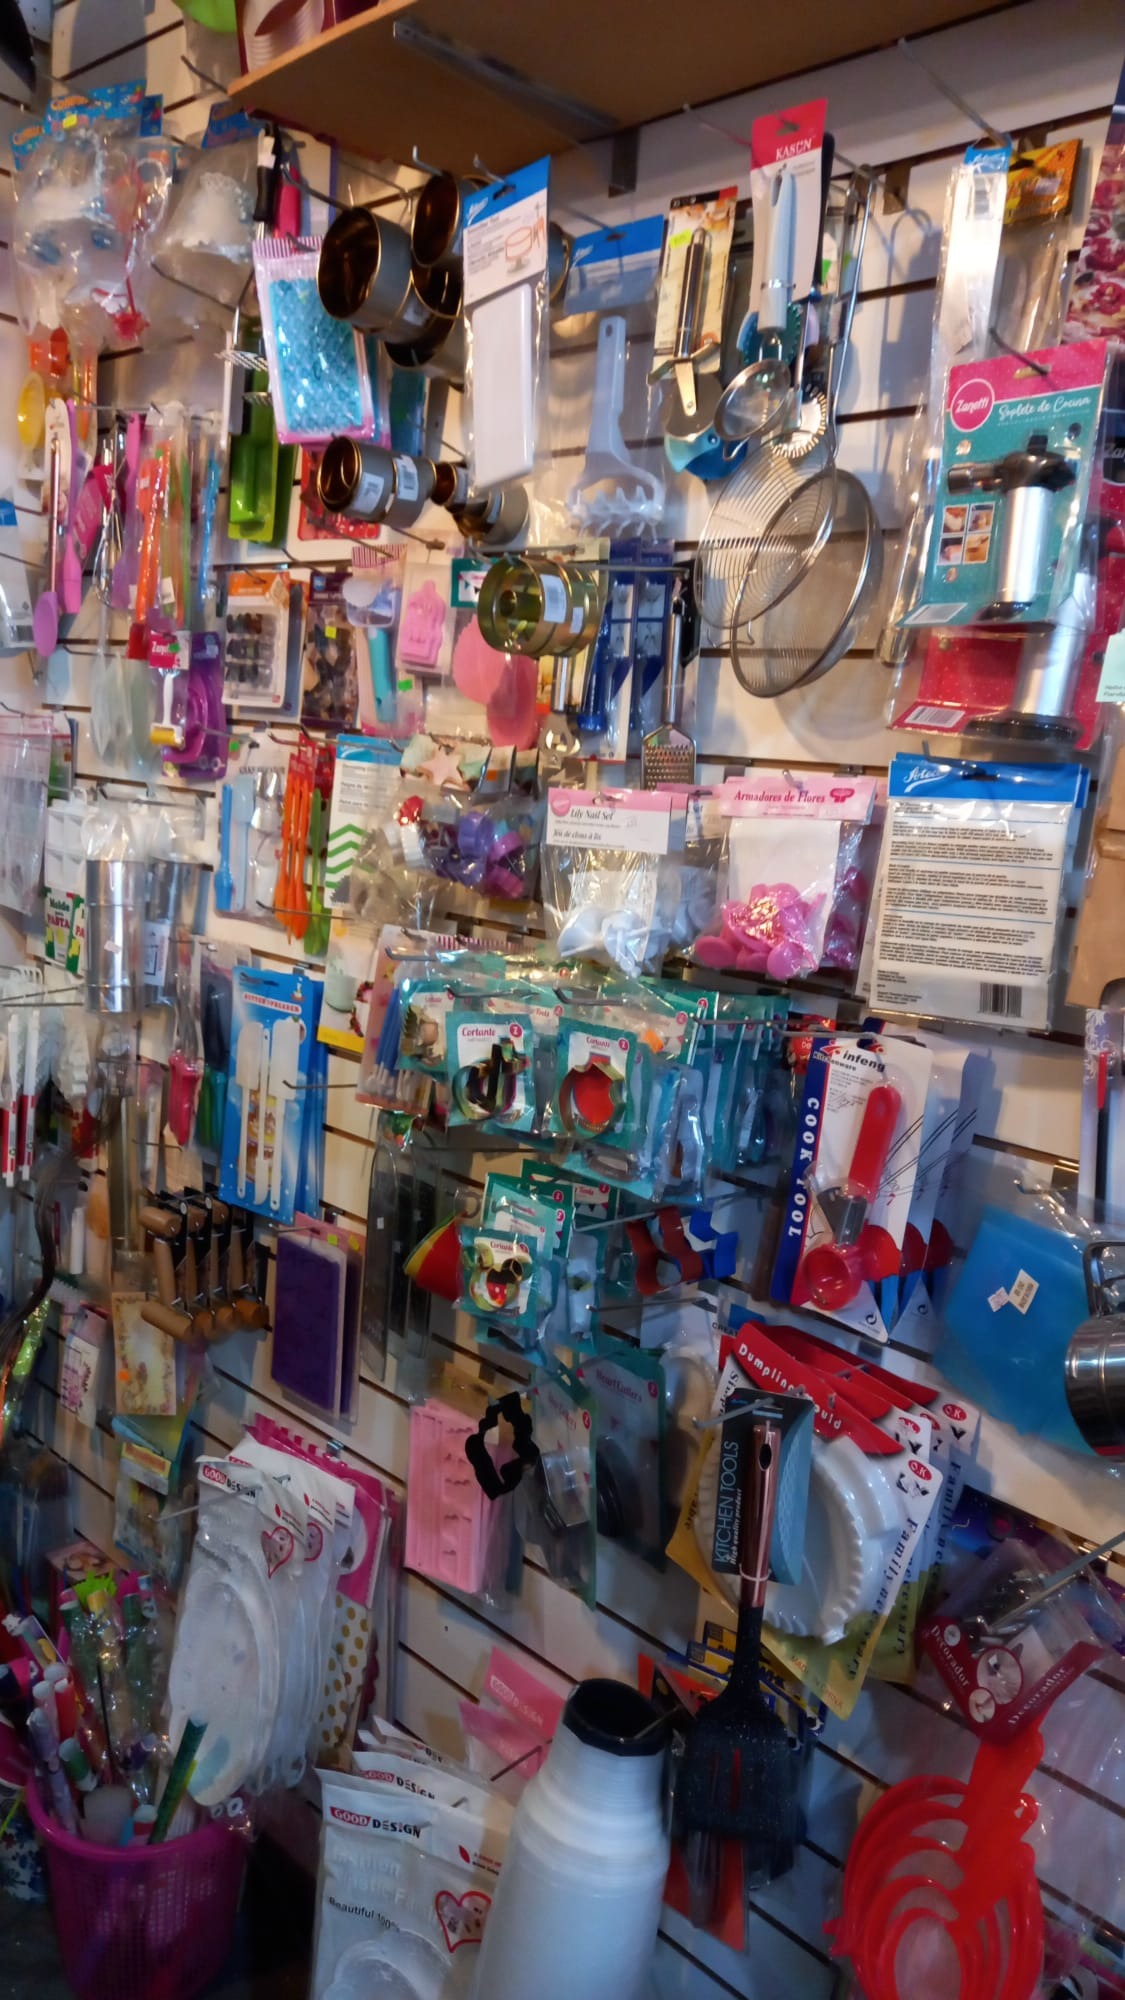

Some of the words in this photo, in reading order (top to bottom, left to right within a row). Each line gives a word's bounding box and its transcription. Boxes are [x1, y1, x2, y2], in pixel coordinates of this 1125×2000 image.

[955, 397, 989, 414] Zanetti
[1037, 402, 1050, 414] de
[734, 789, 782, 803] Armadores
[784, 790, 795, 803] de
[796, 791, 826, 804] Flores
[570, 808, 583, 819] Lily
[585, 809, 601, 820] Nail
[602, 810, 615, 822] Set
[47, 913, 70, 930] PASTA
[461, 1026, 497, 1038] Cortante
[842, 1050, 887, 1073] infeng
[800, 1097, 820, 1162] COOK
[204, 1467, 227, 1485] GOOD
[720, 1440, 739, 1491] TOOLS
[910, 1461, 927, 1476] O.K
[714, 1495, 734, 1563] KITCHEN
[884, 1517, 919, 1581] Family
[930, 1624, 971, 1688] Decorador
[1007, 1666, 1067, 1726] Decorador
[333, 1809, 369, 1827] GOOD
[372, 1819, 422, 1839] DESIGN
[328, 1896, 375, 1919] Beautiful
